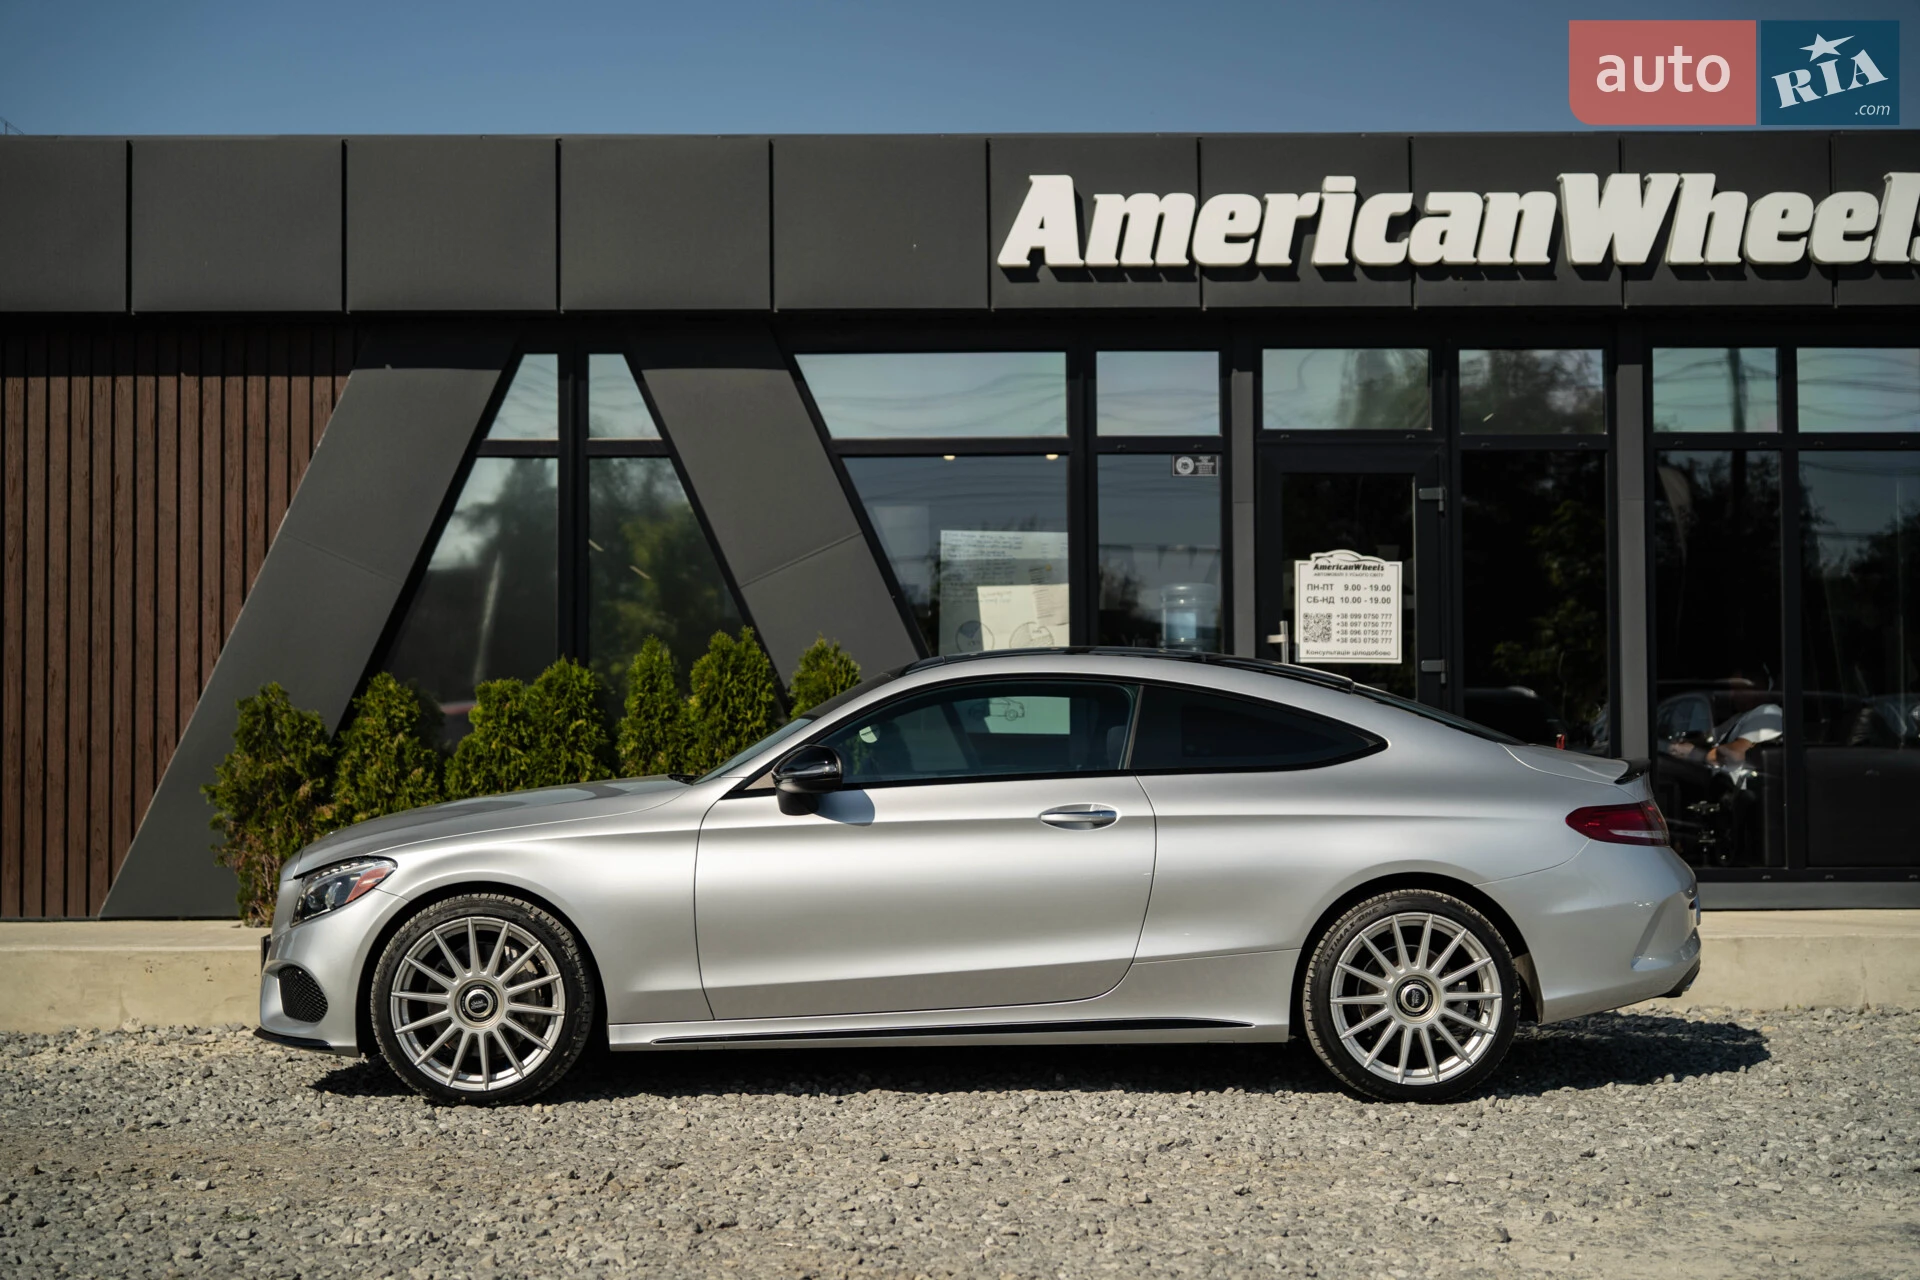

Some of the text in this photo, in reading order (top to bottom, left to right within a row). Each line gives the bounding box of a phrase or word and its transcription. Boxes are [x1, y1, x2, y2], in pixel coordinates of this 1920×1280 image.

[997, 172, 1920, 267] AmericanWheel
[1313, 563, 1385, 572] AmericanWheels
[1306, 583, 1335, 591] ПН-ПТ
[1343, 584, 1362, 592] 9.00
[1369, 584, 1392, 592] 19.00
[1306, 596, 1335, 604] СБ-НД
[1340, 596, 1362, 604] 10.00
[1323, 921, 1355, 967] ALTIMAX
[1358, 906, 1379, 922] ONE
